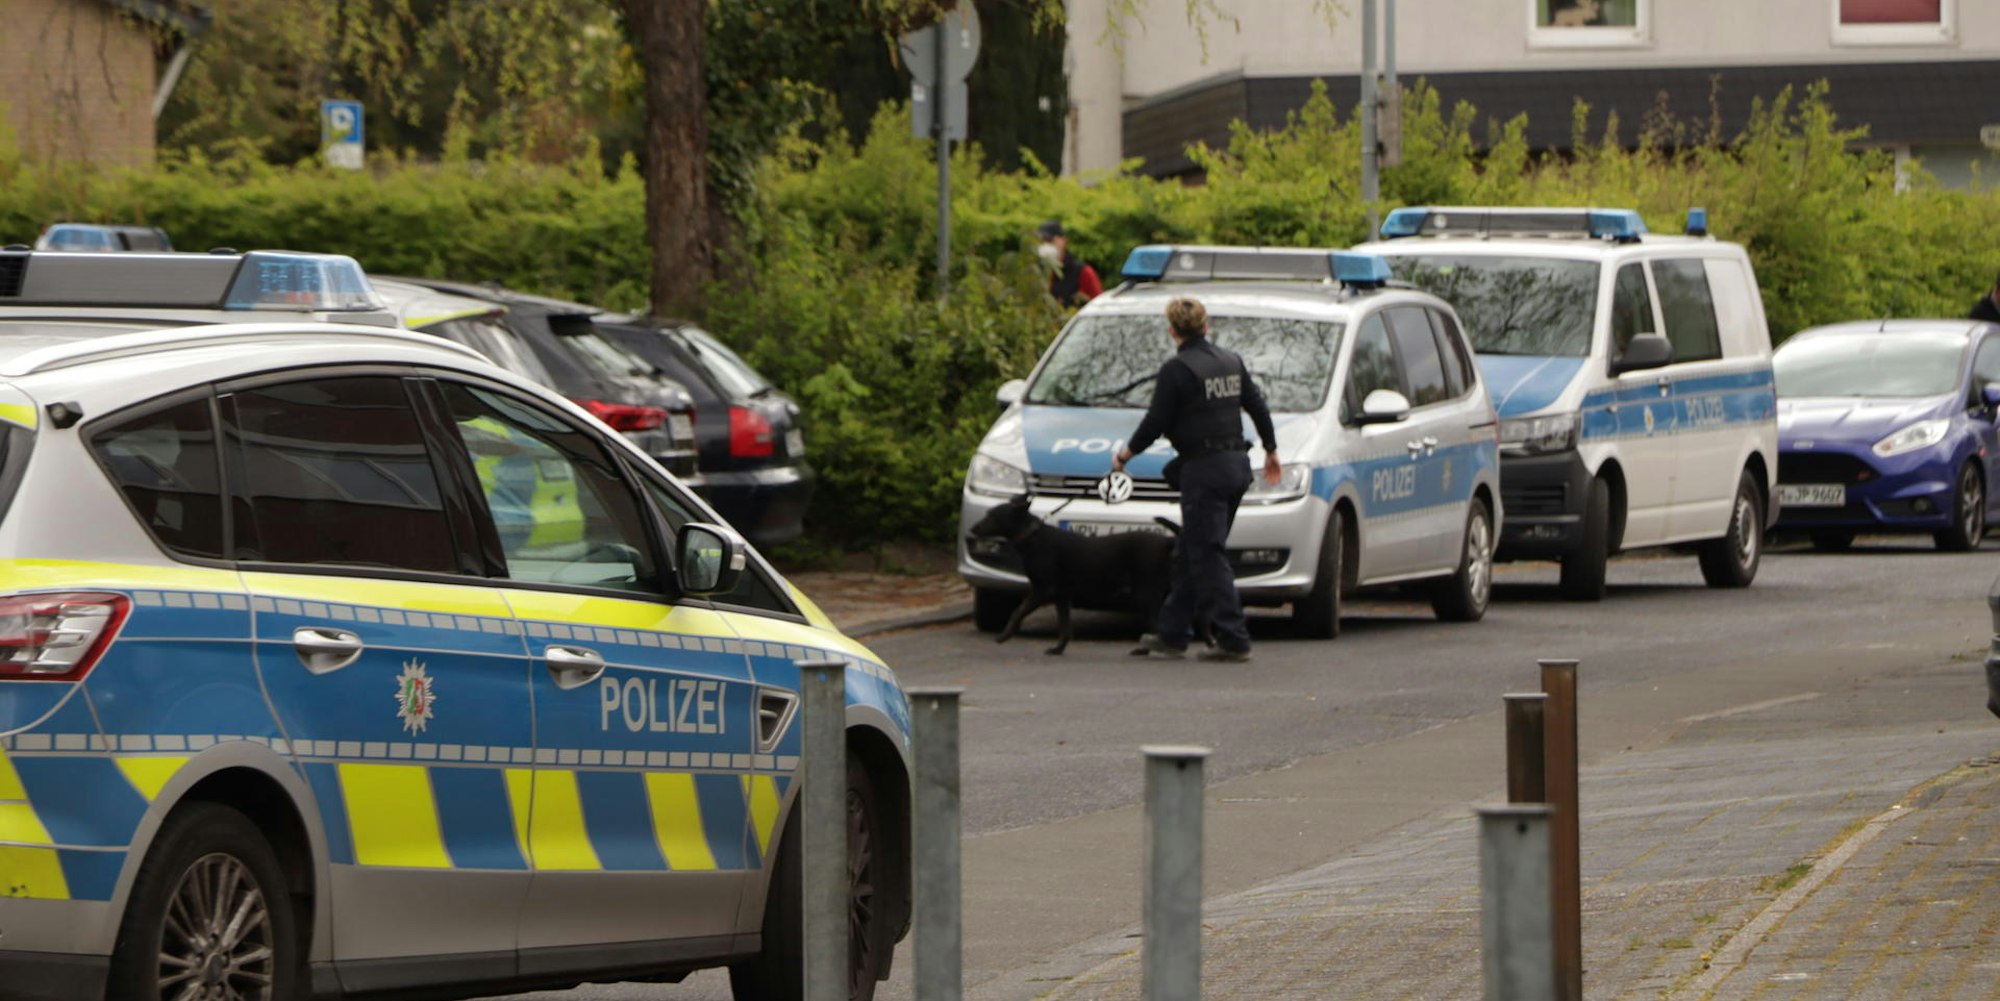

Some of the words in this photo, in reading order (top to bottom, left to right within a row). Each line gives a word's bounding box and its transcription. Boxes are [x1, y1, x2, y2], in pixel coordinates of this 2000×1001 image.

[1684, 396, 1725, 427] POLIZEI
[1373, 464, 1415, 502] POLIZEI
[601, 677, 726, 735] POLIZEI
